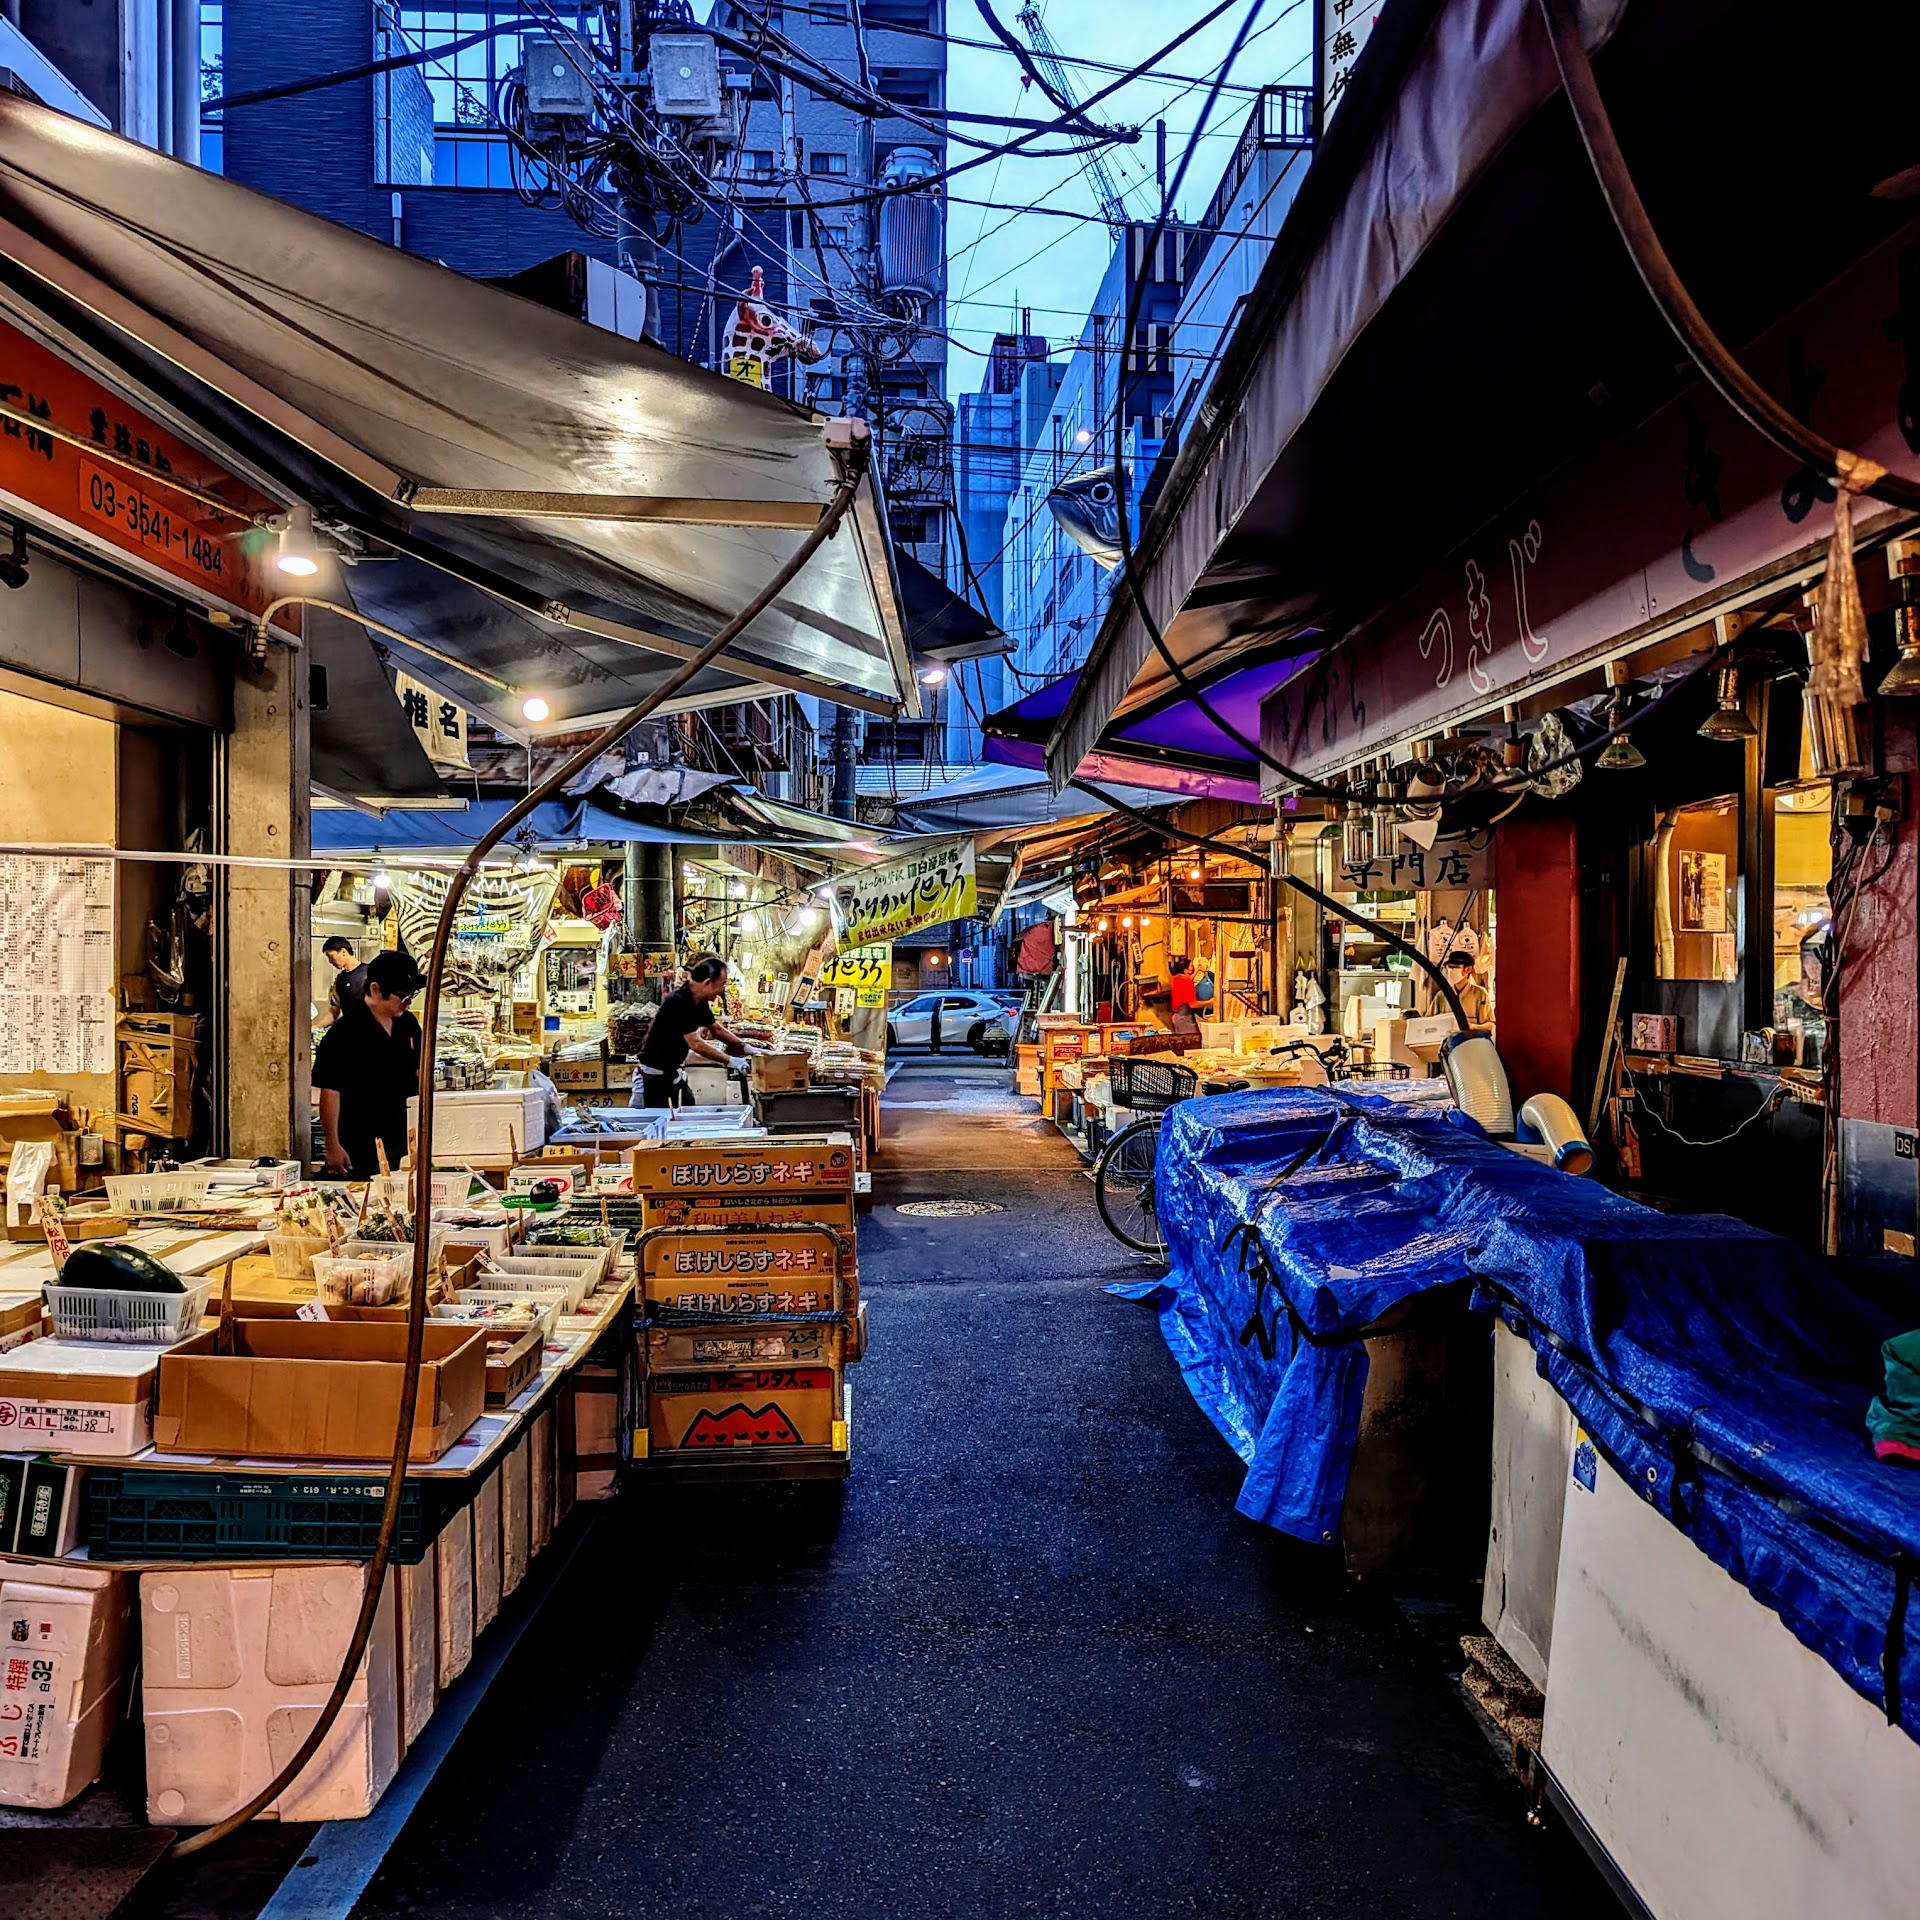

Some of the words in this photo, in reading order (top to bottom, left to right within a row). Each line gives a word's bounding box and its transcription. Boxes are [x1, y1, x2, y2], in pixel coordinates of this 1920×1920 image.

[91, 474, 222, 576] 03-3541-1484
[1418, 519, 1549, 694] つきじ
[403, 688, 460, 739] 椎名
[849, 863, 966, 927] ふりかけとろろ
[1896, 1136, 1911, 1155] DS
[672, 1160, 815, 1186] ぼけしらずネギ
[675, 1249, 818, 1273] ぼけしらずネギ
[677, 1290, 819, 1313] ぼけしらずネギ
[24, 1416, 36, 1426] A
[45, 1417, 57, 1427] L
[5, 1658, 30, 1692] 特撰
